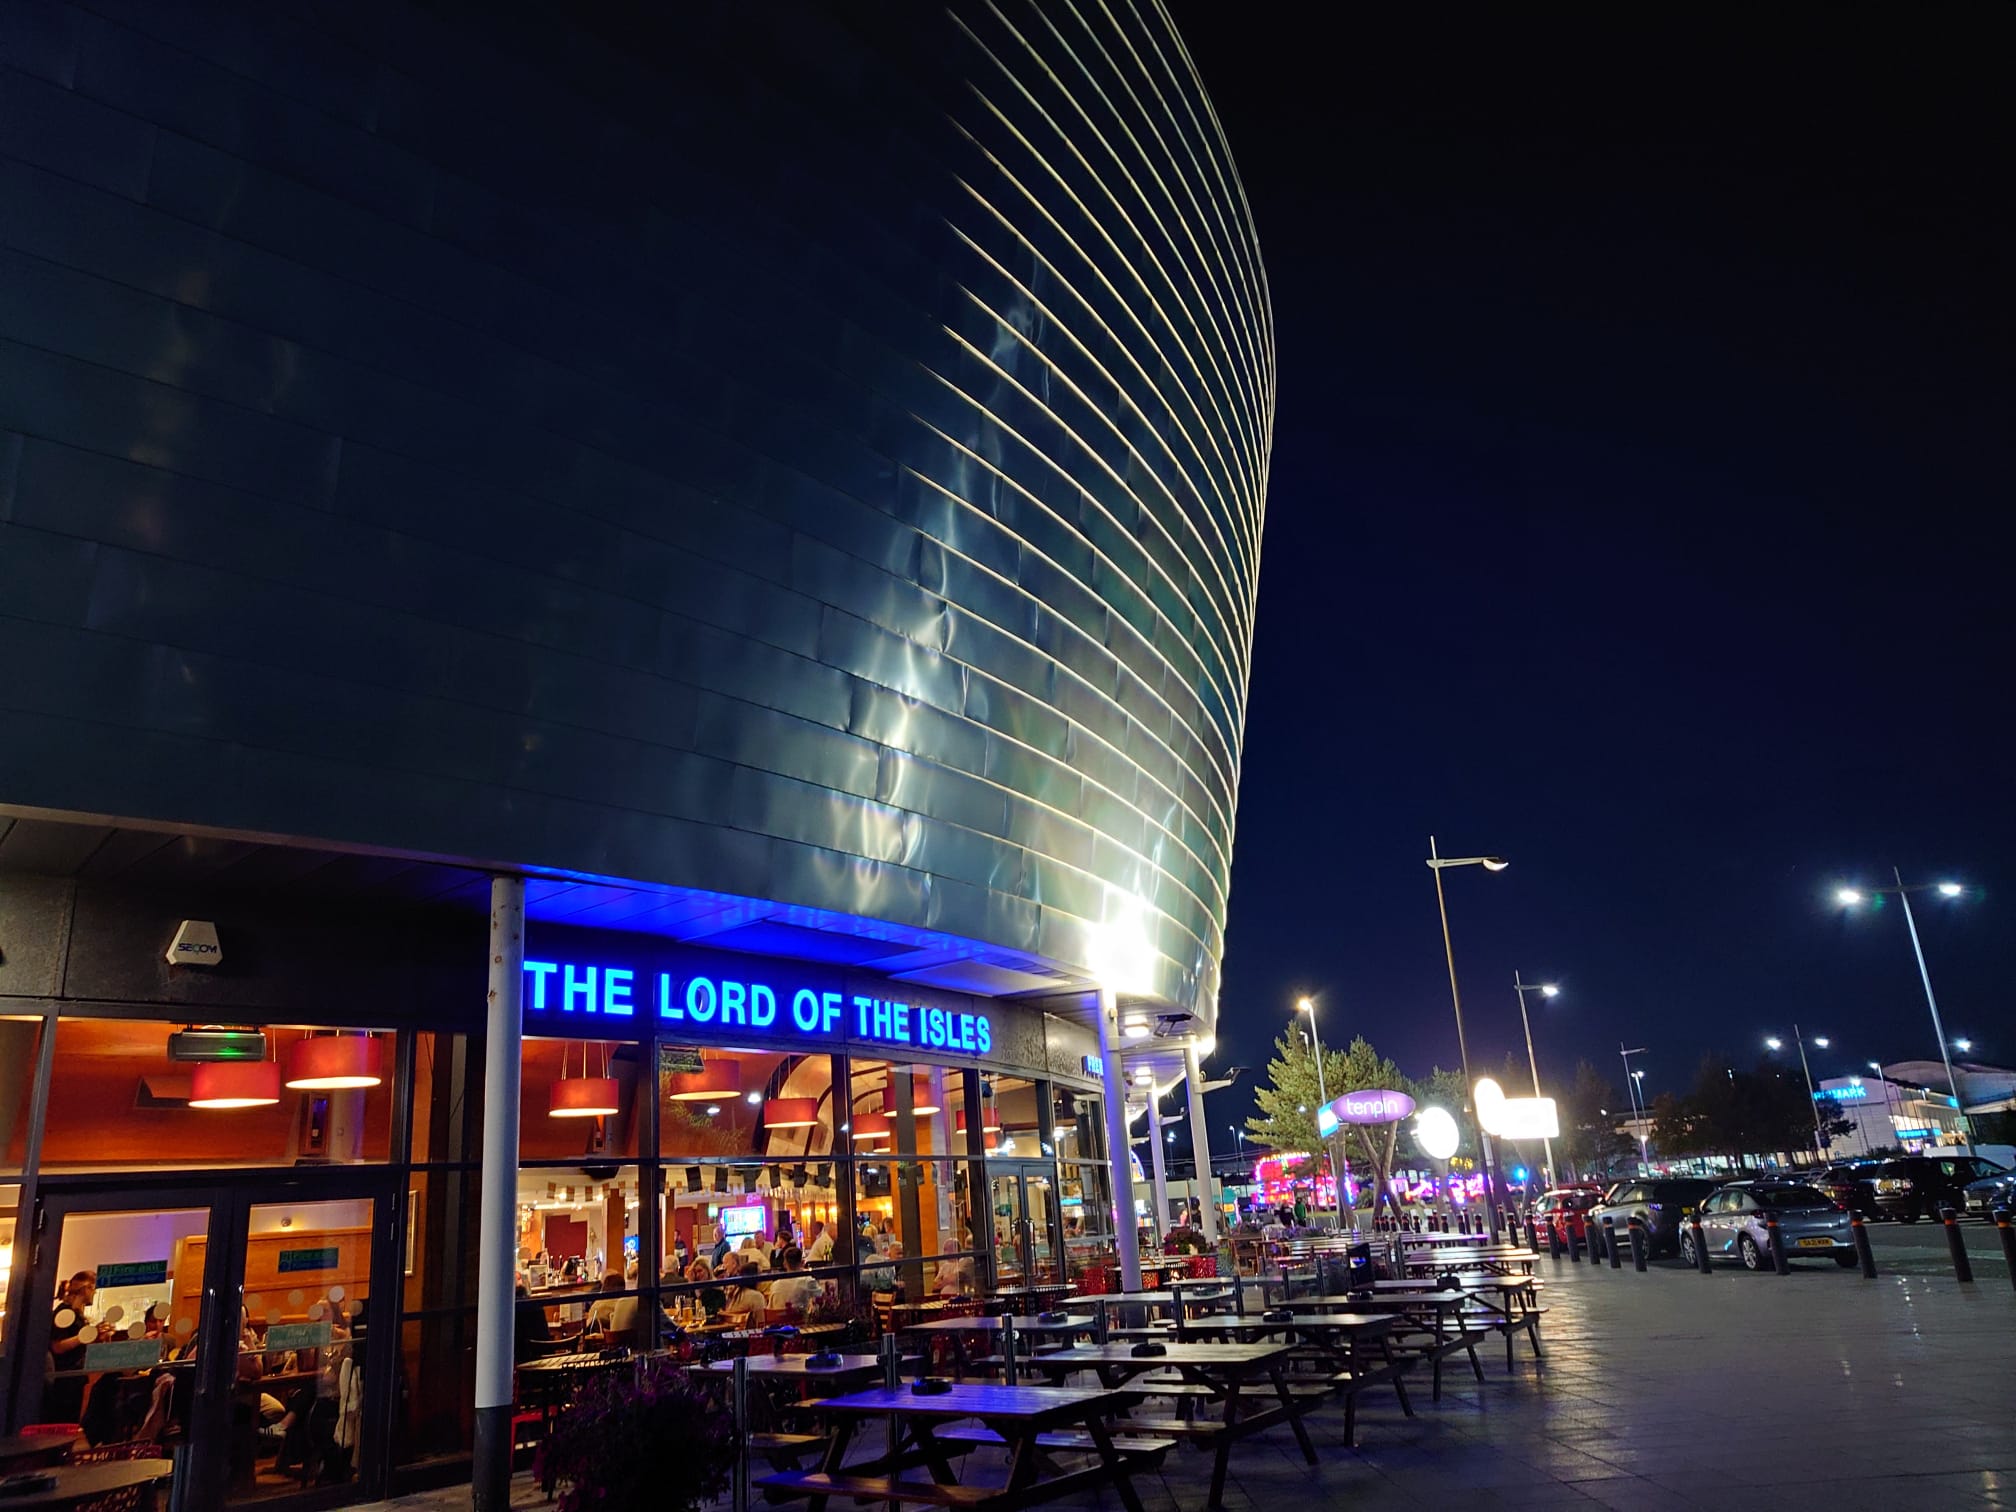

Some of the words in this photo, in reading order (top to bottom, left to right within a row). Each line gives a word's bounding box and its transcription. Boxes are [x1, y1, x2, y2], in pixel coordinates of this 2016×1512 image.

[177, 942, 217, 955] SECOM
[522, 960, 634, 1016] THE
[660, 973, 775, 1027] LORD
[792, 988, 843, 1033] OF
[853, 995, 911, 1042] THE
[919, 1005, 992, 1054] ISLES
[1346, 1097, 1399, 1119] tenpin
